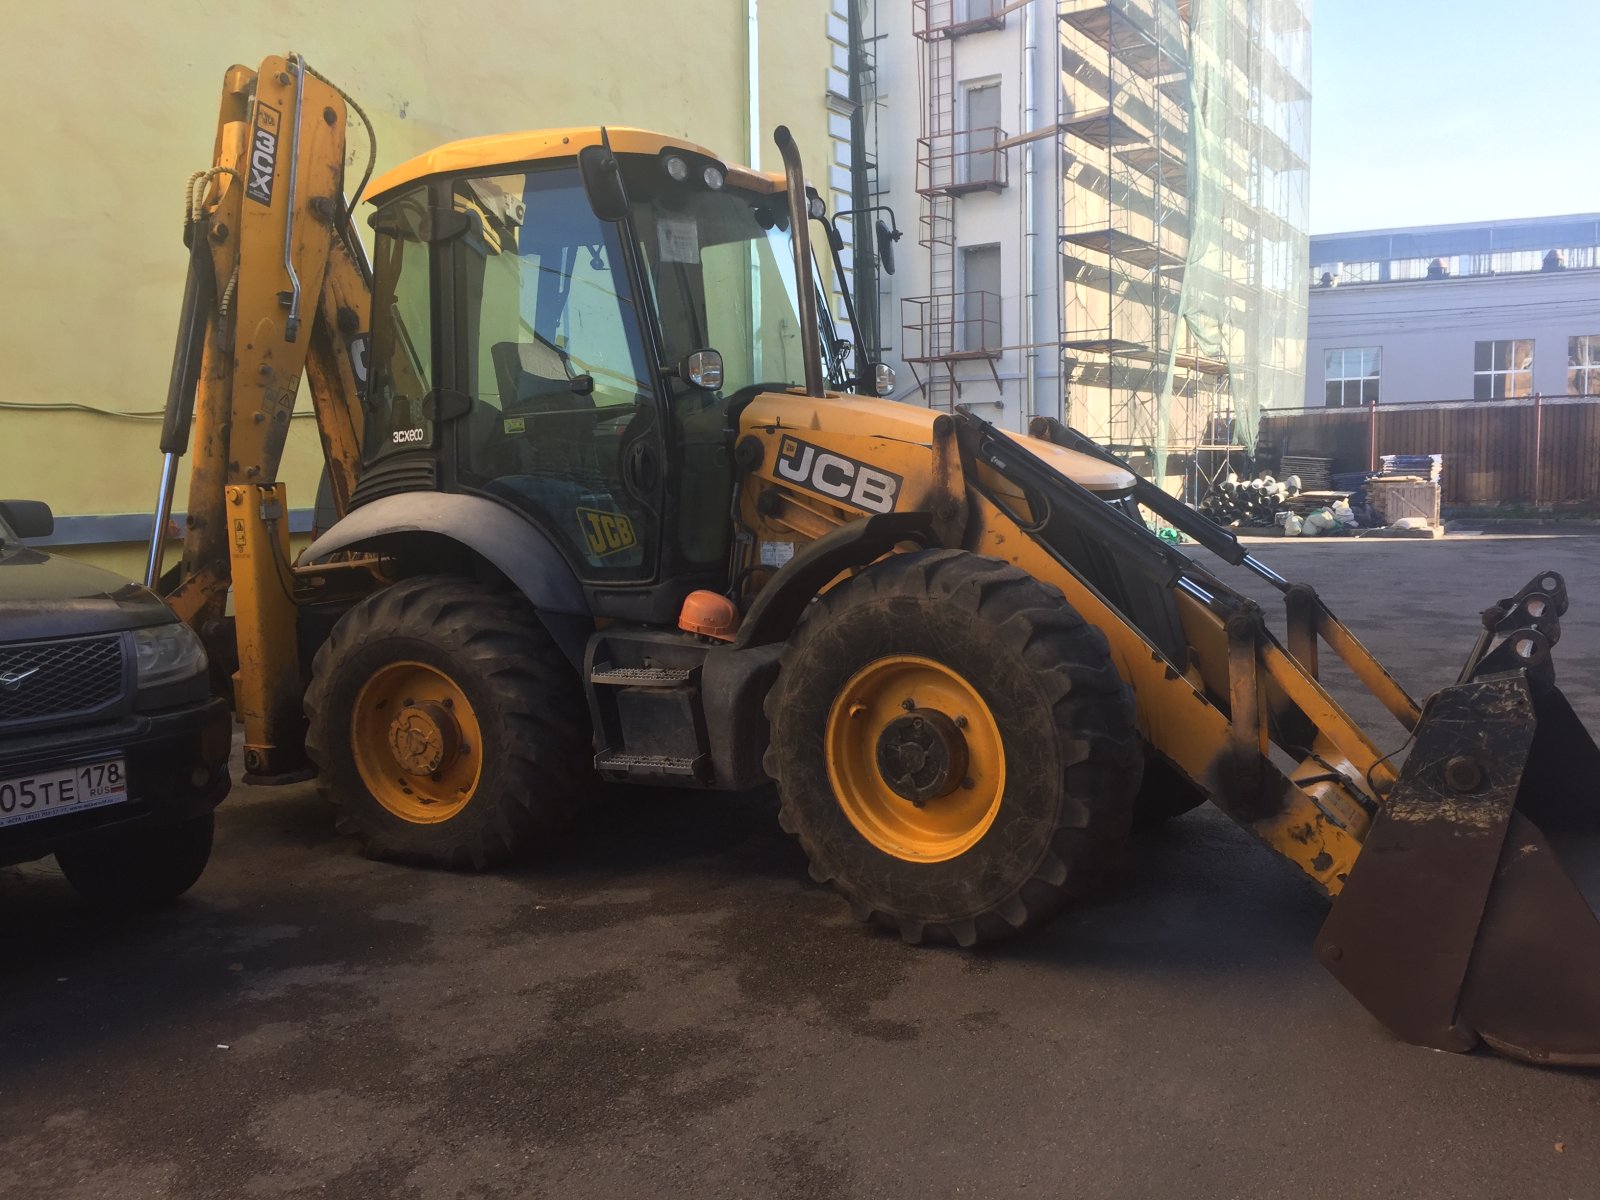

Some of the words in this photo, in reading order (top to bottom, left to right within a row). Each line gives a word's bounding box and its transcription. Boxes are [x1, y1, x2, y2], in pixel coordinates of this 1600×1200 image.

[249, 130, 275, 194] 3CX
[778, 446, 898, 514] JCB
[586, 511, 634, 554] JCB
[80, 763, 120, 789] 178
[89, 786, 111, 798] RUS
